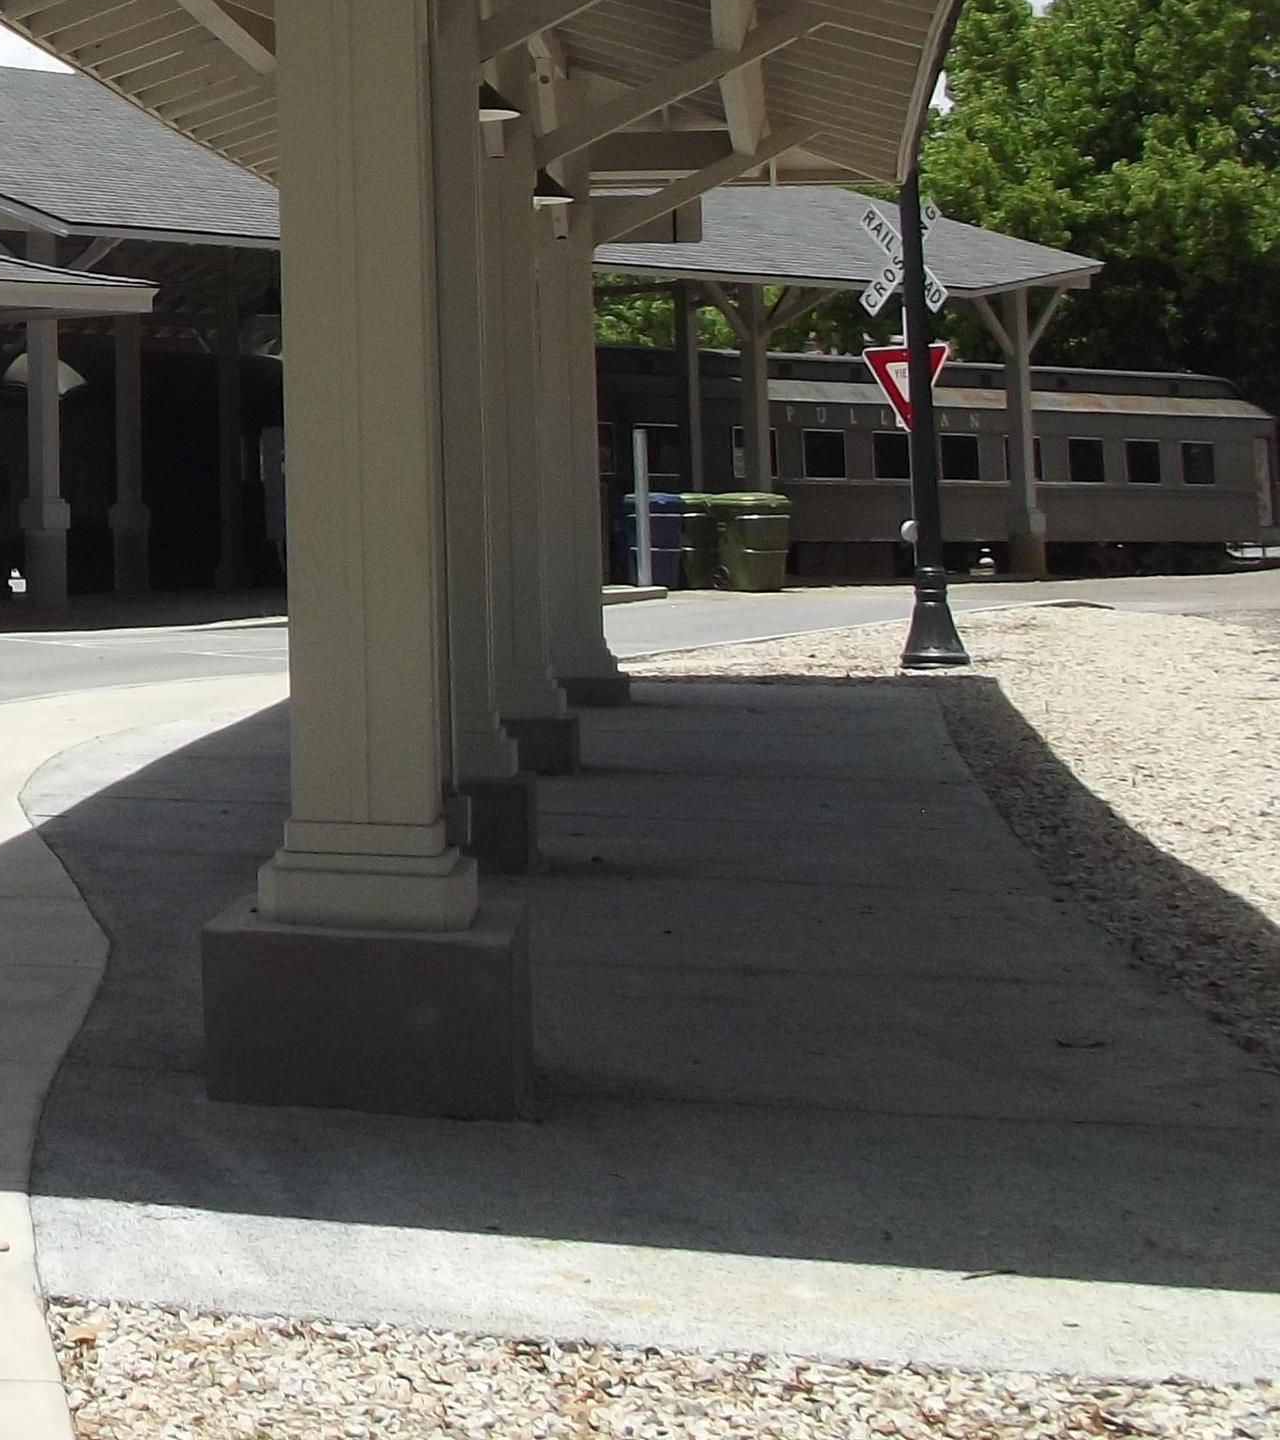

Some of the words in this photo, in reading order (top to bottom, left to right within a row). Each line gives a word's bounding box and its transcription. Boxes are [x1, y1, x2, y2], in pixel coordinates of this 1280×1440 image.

[862, 210, 941, 304] RAILAD
[864, 206, 936, 308] CROSNG
[785, 405, 980, 429] PULLAN
